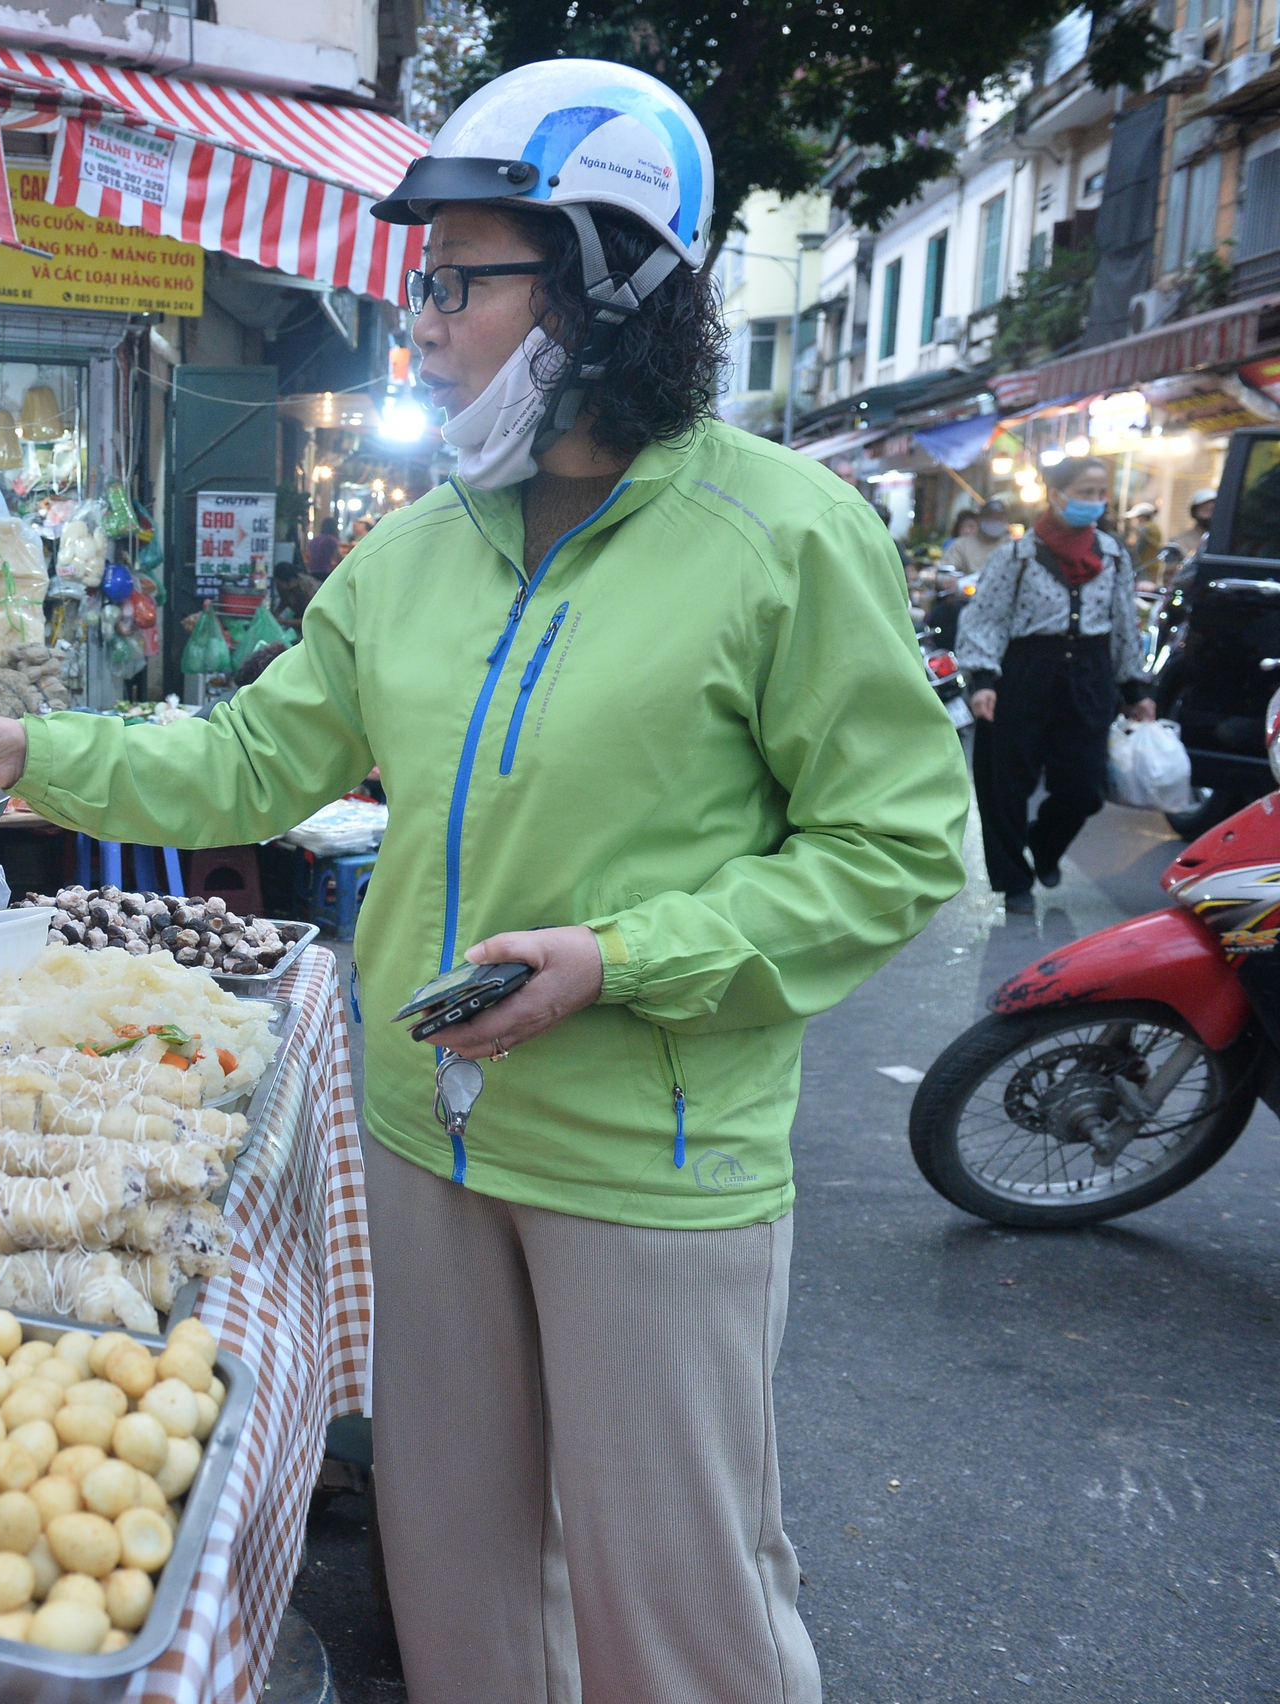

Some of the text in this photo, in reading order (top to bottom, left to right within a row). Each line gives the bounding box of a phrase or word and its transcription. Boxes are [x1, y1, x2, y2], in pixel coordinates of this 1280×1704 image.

[653, 175, 670, 191] Việt
[54, 265, 81, 281] CÁC
[516, 427, 525, 436] TO
[523, 410, 538, 427] WEAR
[567, 611, 582, 644] SPORTS
[724, 1174, 758, 1183] EXTREME
